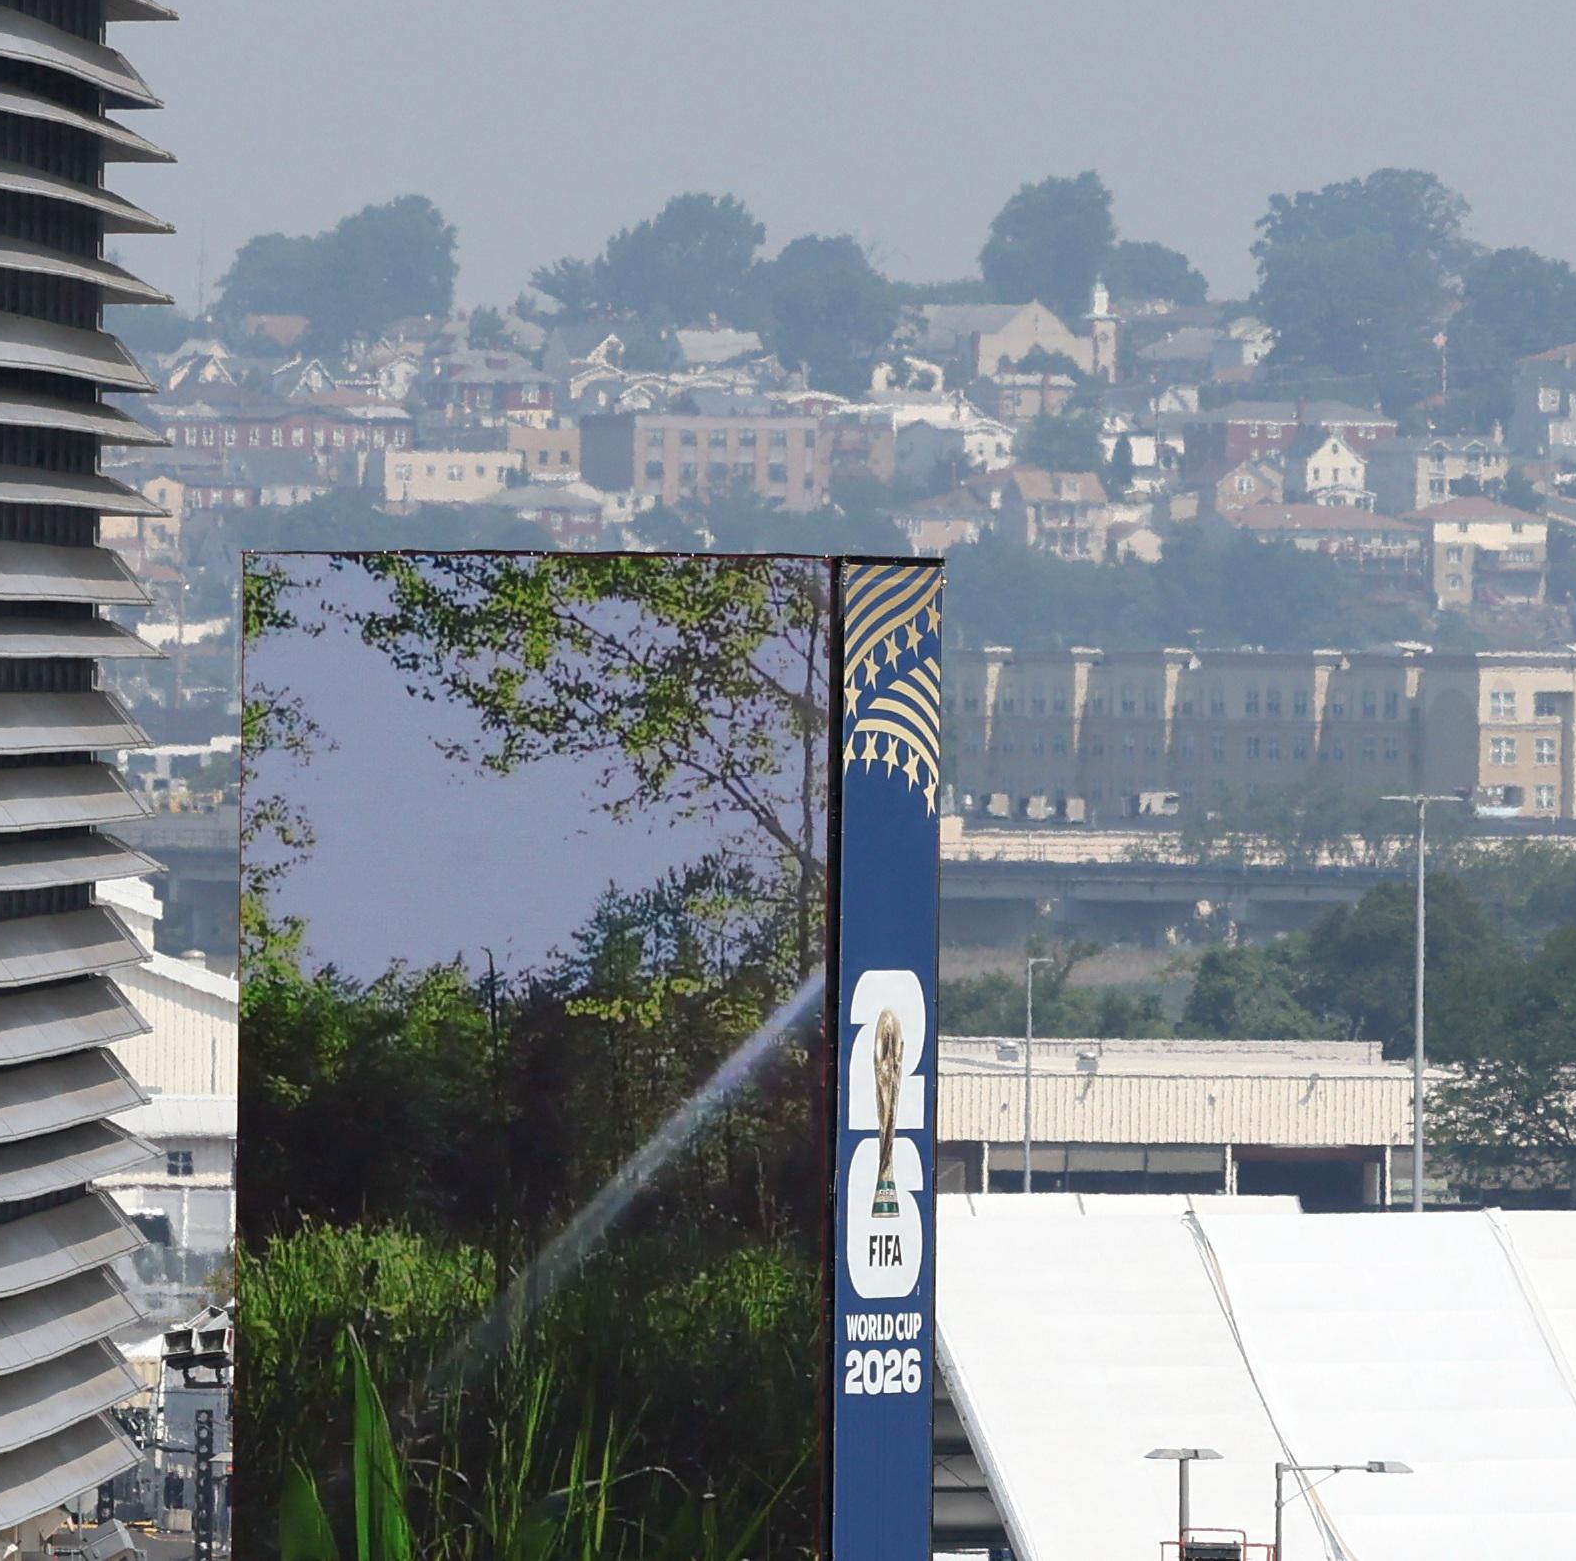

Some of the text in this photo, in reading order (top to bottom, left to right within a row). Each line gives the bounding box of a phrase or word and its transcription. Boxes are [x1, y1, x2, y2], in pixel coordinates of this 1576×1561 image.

[869, 1235, 903, 1267] FIFA
[846, 1312, 922, 1342] WORLD CUP
[845, 1348, 922, 1395] 2026
